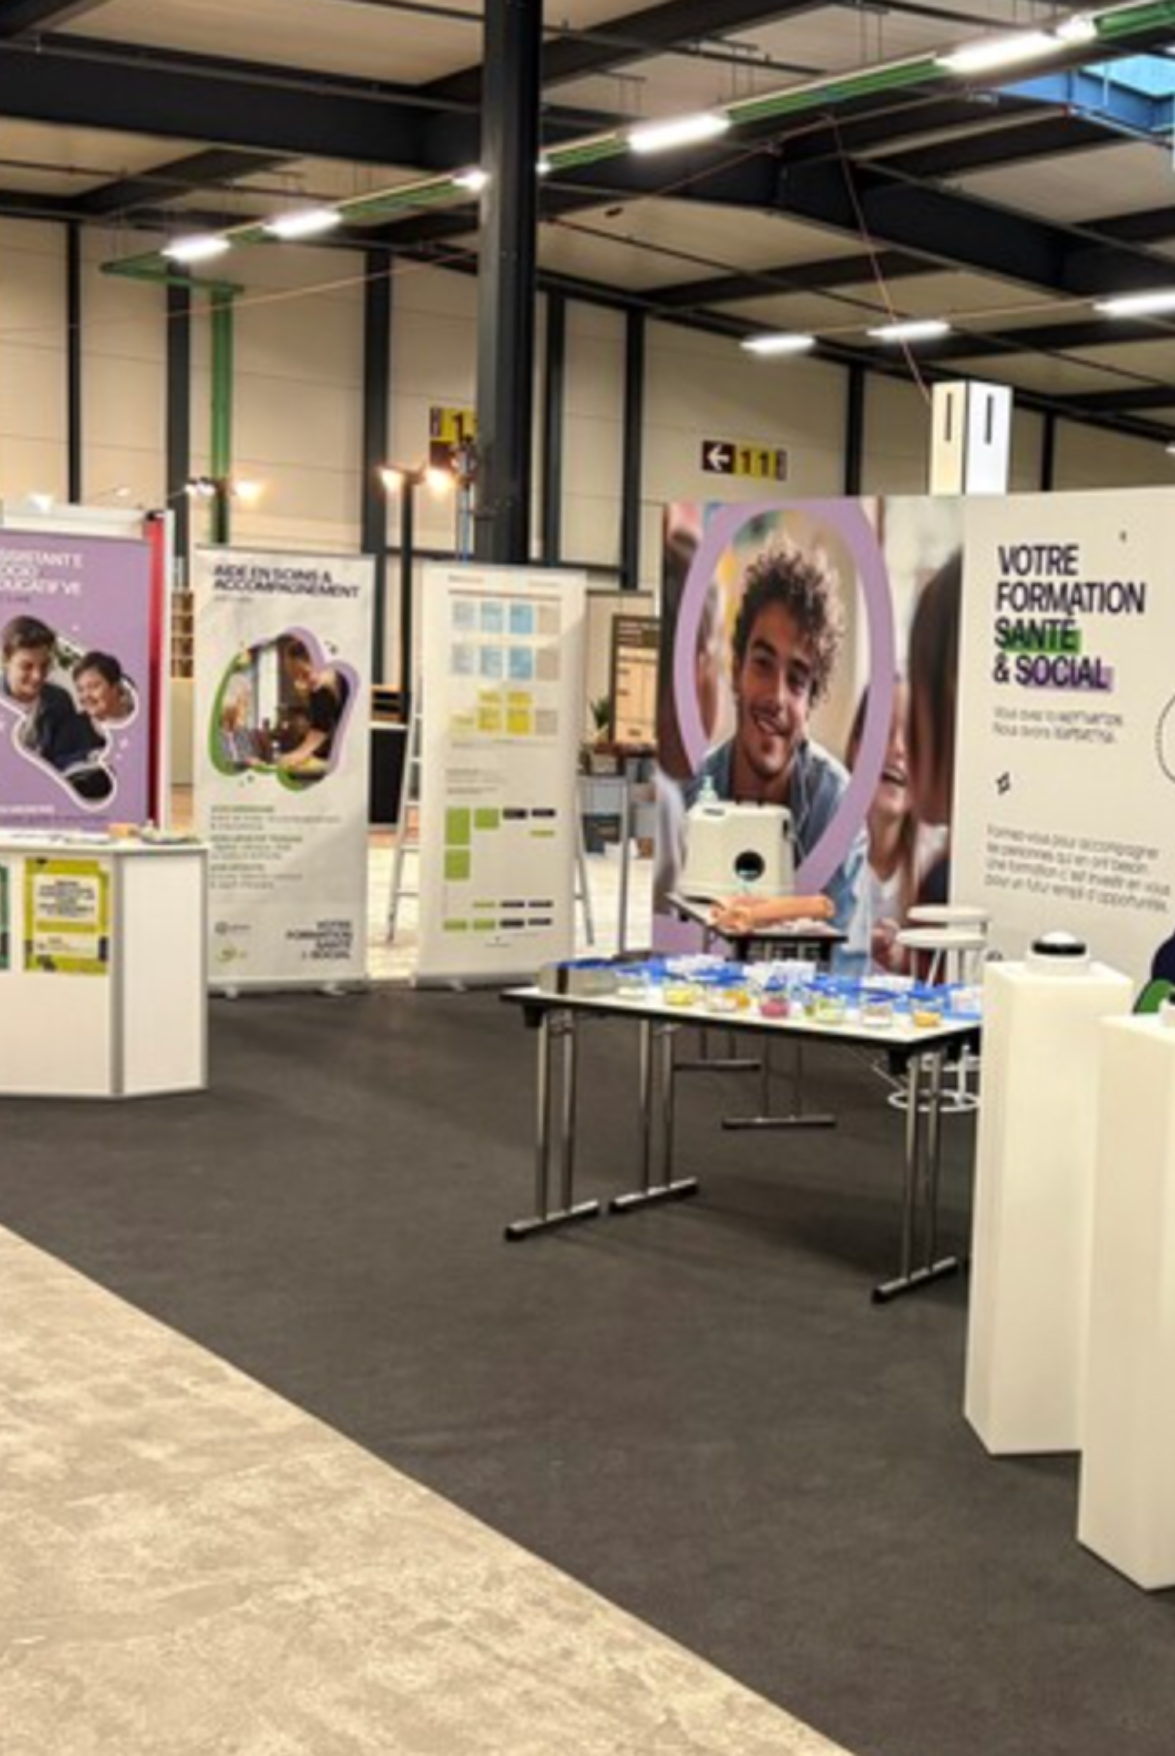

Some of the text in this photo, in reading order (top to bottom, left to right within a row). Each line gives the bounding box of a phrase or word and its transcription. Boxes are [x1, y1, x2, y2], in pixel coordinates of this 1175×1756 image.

[740, 450, 769, 478] 11
[998, 544, 1079, 576] VOTRE
[995, 581, 1147, 613] FORMATION
[994, 610, 1078, 650] SANTÉ
[993, 653, 1110, 689] & SOCIAL
